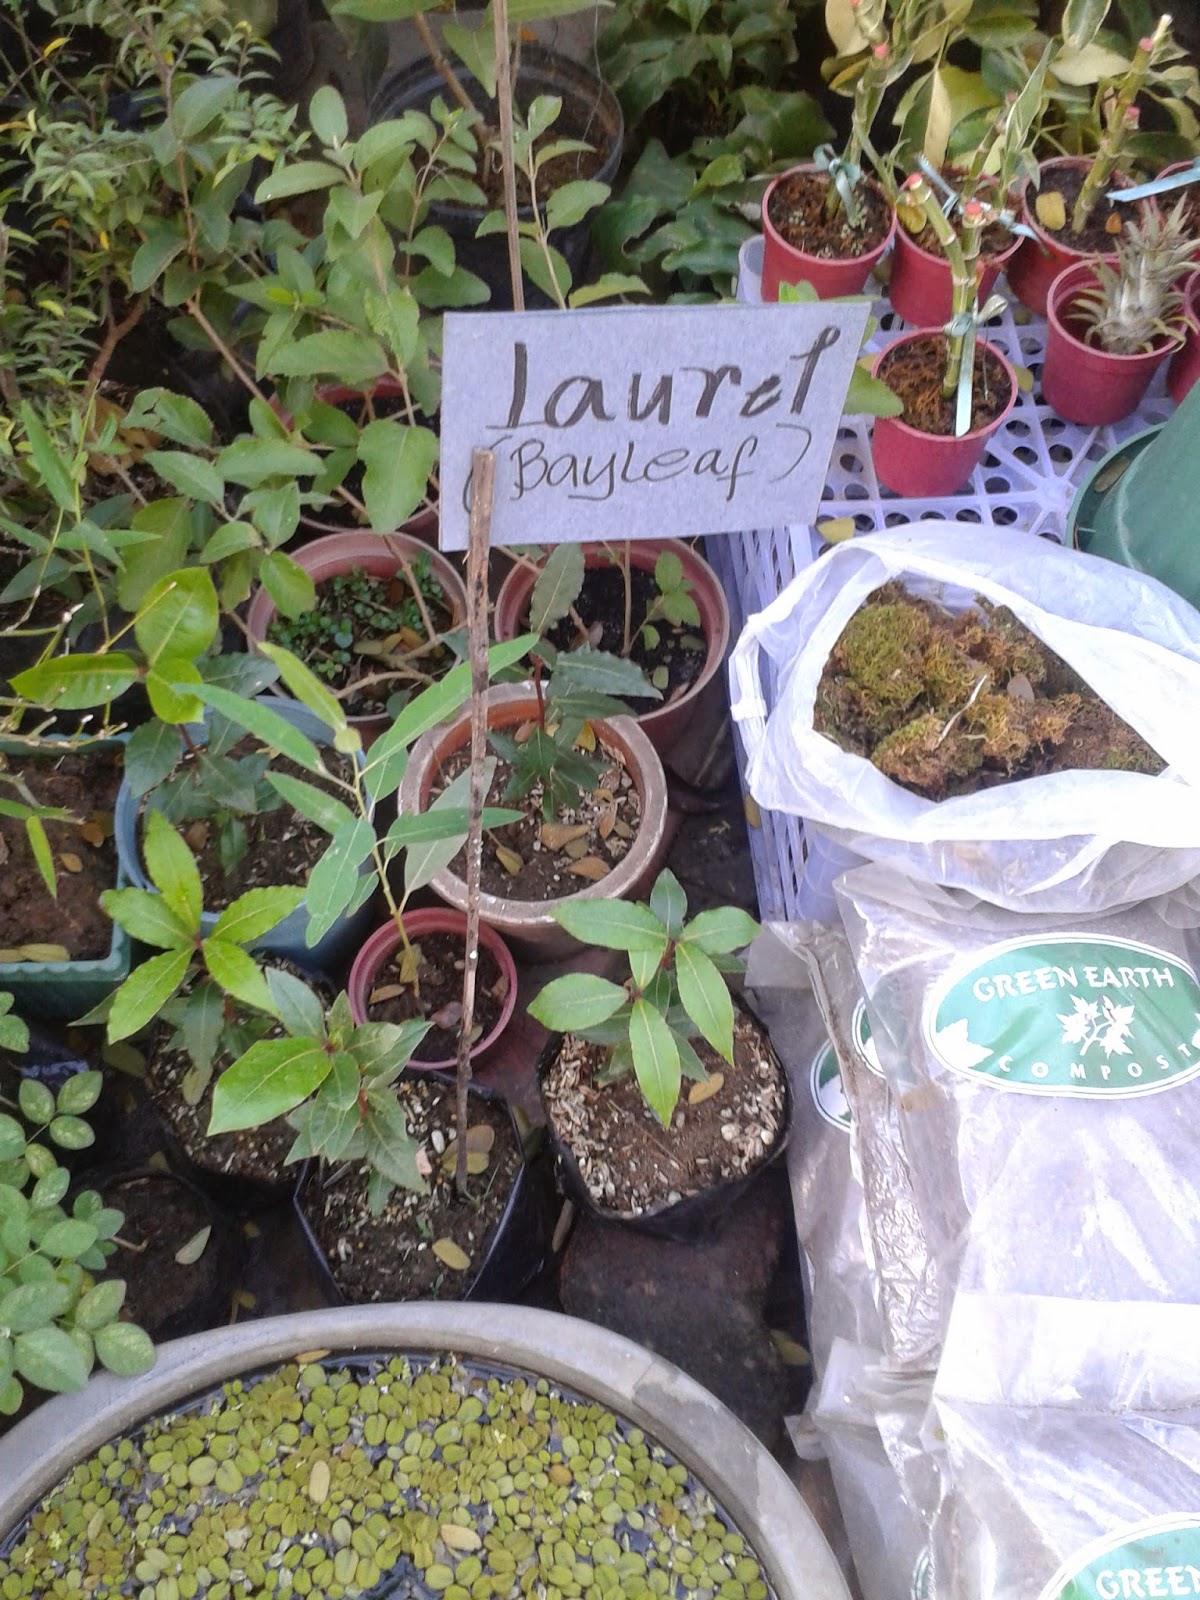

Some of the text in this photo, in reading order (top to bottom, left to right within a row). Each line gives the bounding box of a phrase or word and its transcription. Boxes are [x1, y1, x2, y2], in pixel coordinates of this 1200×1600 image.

[973, 965, 1175, 1002] GREEN EARTH
[999, 1043, 1192, 1080] COMPOST
